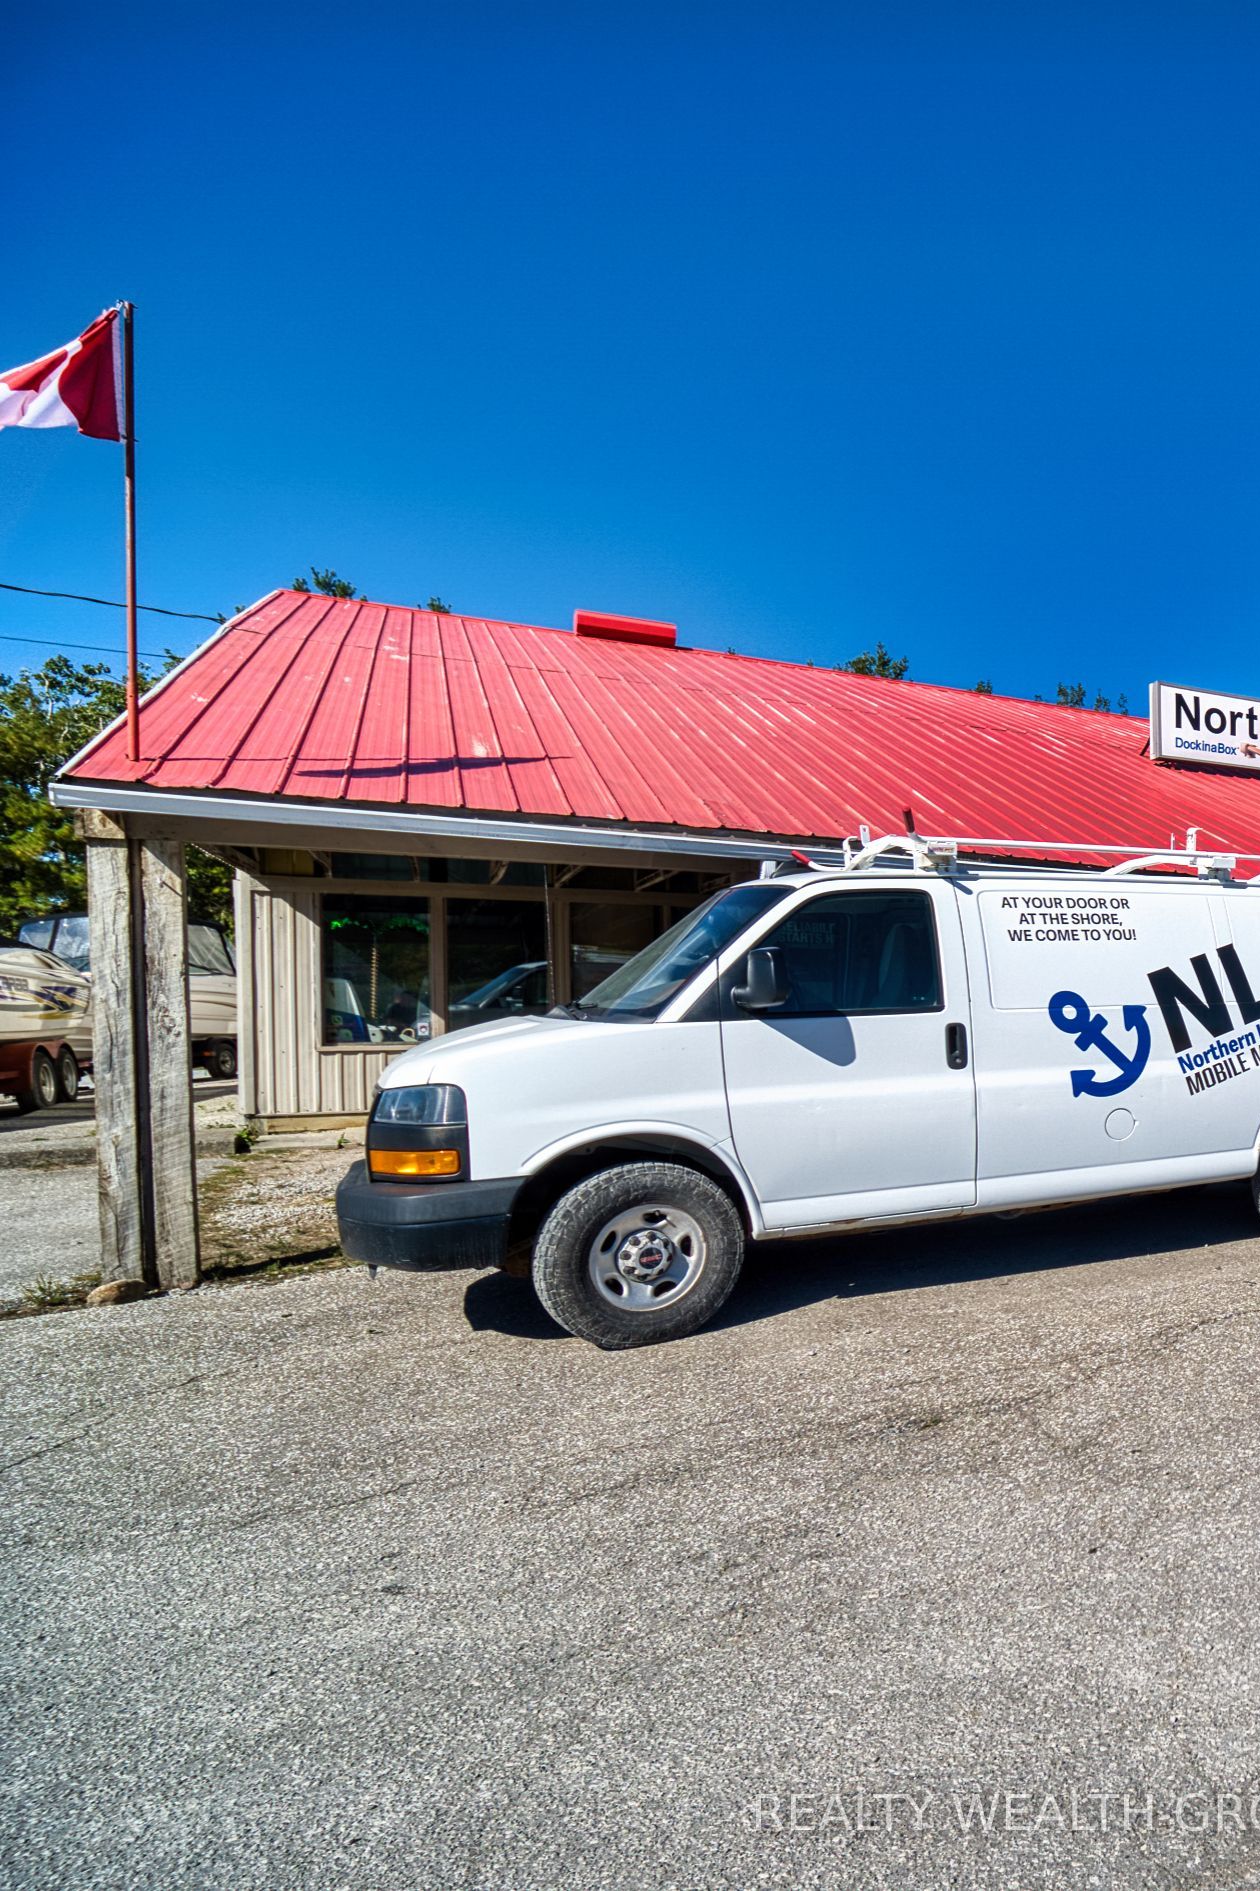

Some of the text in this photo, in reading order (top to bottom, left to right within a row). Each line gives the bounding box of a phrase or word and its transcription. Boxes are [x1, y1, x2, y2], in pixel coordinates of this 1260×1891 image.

[1175, 737, 1238, 756] DockinaBox
[1001, 896, 1131, 910] AT YOUR DOOR OR
[1019, 912, 1123, 927] AT THE SHORE,
[1007, 928, 1137, 942] WE COME TO YOU!
[1177, 1029, 1257, 1075] Northern
[1185, 1052, 1251, 1096] MOBILE
